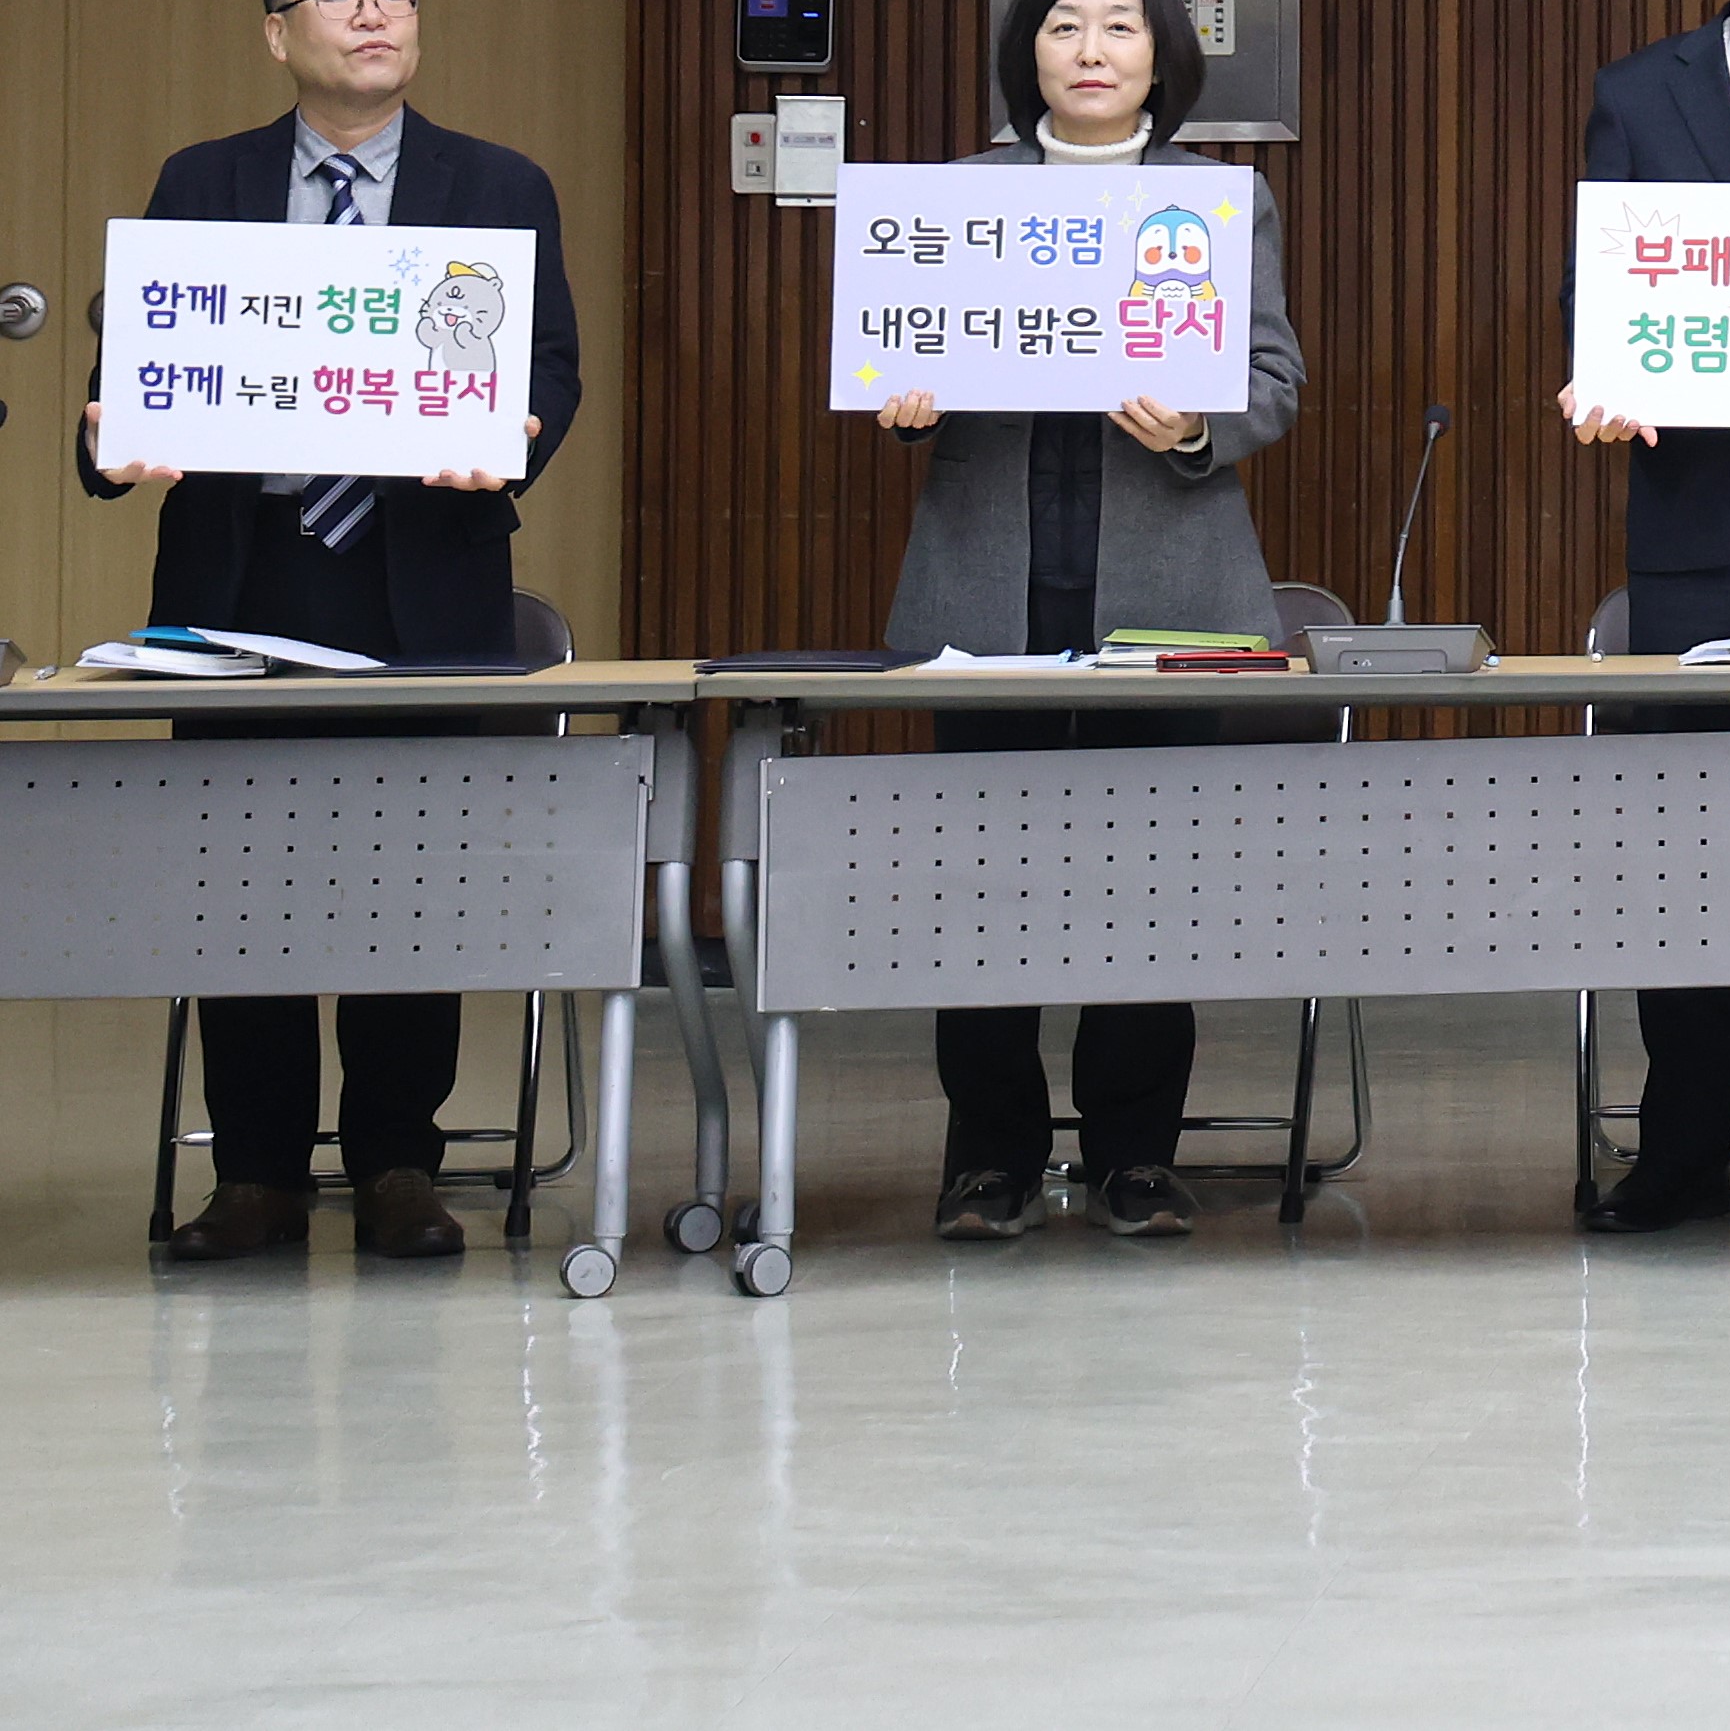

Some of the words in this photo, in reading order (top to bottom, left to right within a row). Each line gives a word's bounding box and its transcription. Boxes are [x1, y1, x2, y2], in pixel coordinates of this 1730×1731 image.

[862, 217, 950, 265] 오늘
[966, 218, 1004, 259] 더
[1020, 216, 1103, 266] 청렴
[141, 280, 227, 329] 함께
[240, 294, 302, 329] 지킨
[317, 285, 401, 335] 청렴
[862, 306, 946, 355] 내일
[963, 308, 1001, 349] 더
[1017, 307, 1103, 355] 밝은
[1118, 299, 1224, 359] 달서
[138, 361, 223, 410] 함께
[236, 375, 299, 410] 누릴
[313, 366, 399, 416] 행복
[415, 369, 498, 417] 달서
